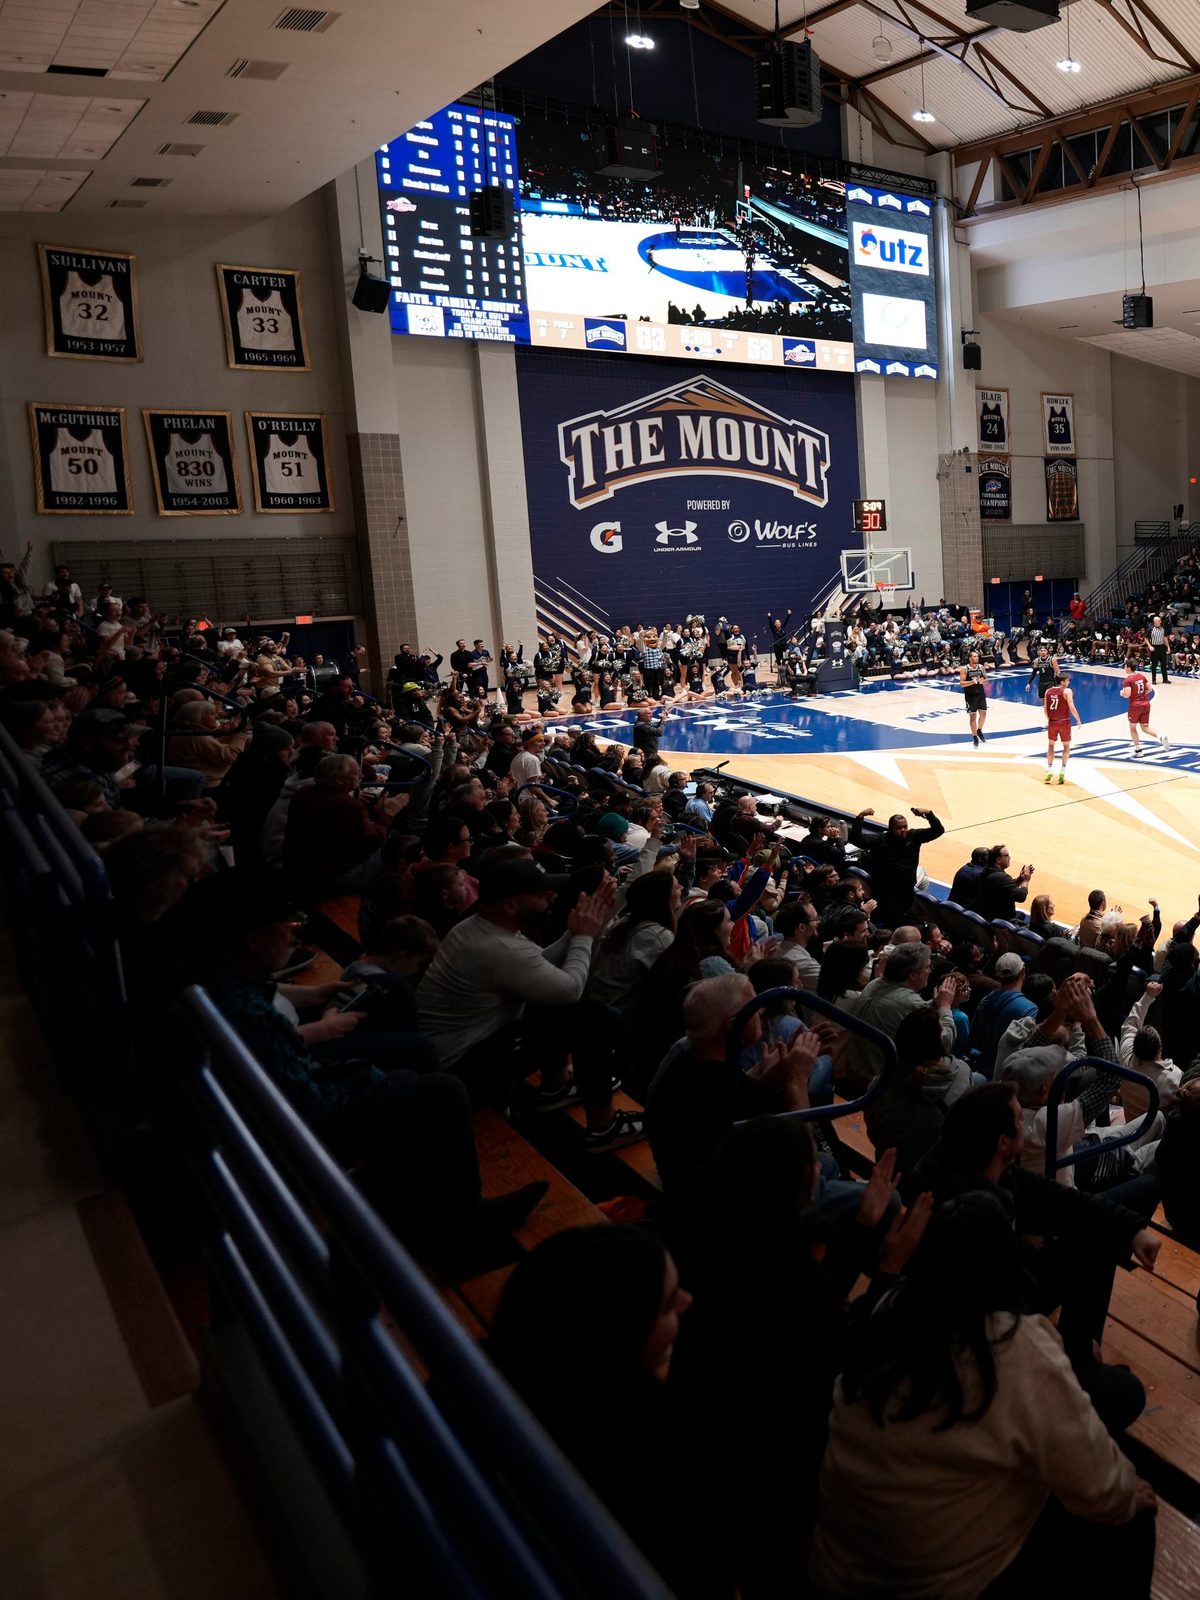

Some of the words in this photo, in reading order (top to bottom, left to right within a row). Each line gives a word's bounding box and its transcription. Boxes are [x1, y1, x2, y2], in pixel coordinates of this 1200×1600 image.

[879, 238, 923, 267] utz
[51, 254, 127, 273] SULLIVAN
[233, 273, 287, 289] CARTER
[70, 290, 113, 303] MOUNT
[395, 291, 433, 306] FAITH.
[435, 295, 480, 310] FAMILY.
[78, 303, 109, 322] 32
[246, 306, 282, 317] MOUNT
[451, 309, 473, 318] TODAY
[475, 311, 487, 319] WE
[488, 312, 509, 321] BUILD
[252, 317, 279, 334] 33
[460, 316, 502, 327] CHAMPIONS
[453, 322, 462, 330] IN
[463, 323, 509, 334] COMPETITION
[448, 329, 463, 338] AND
[465, 330, 473, 338] IN
[474, 331, 516, 342] CHARACTER
[67, 339, 126, 354] 1953-1957
[244, 352, 296, 364] 1965-1969
[981, 392, 1002, 402] BLAIR
[40, 411, 119, 428] McGUTHRIE
[163, 417, 216, 431] PHELAN
[983, 414, 1001, 422] MOUNT
[258, 420, 316, 433] O'REILLY
[986, 422, 998, 435] 24
[1053, 423, 1065, 434] 35
[60, 445, 103, 457] MOUNT
[175, 449, 214, 459] MOUNT
[273, 450, 308, 460] MOUNT
[571, 416, 666, 489] THE
[676, 415, 820, 489] MOUNT
[67, 458, 99, 477] 50
[176, 460, 216, 477] 830
[281, 461, 304, 477] 51
[978, 463, 990, 474] THE
[989, 462, 1010, 475] MOUNT
[185, 478, 213, 489] WINS
[172, 496, 229, 507] 1954-2003
[269, 496, 321, 506] 1960-1963
[687, 500, 720, 511] POWERED
[721, 500, 731, 511] BY
[863, 501, 882, 512] 5:09
[981, 499, 1009, 507] CHAMPIONS
[1049, 698, 1060, 710] 21
